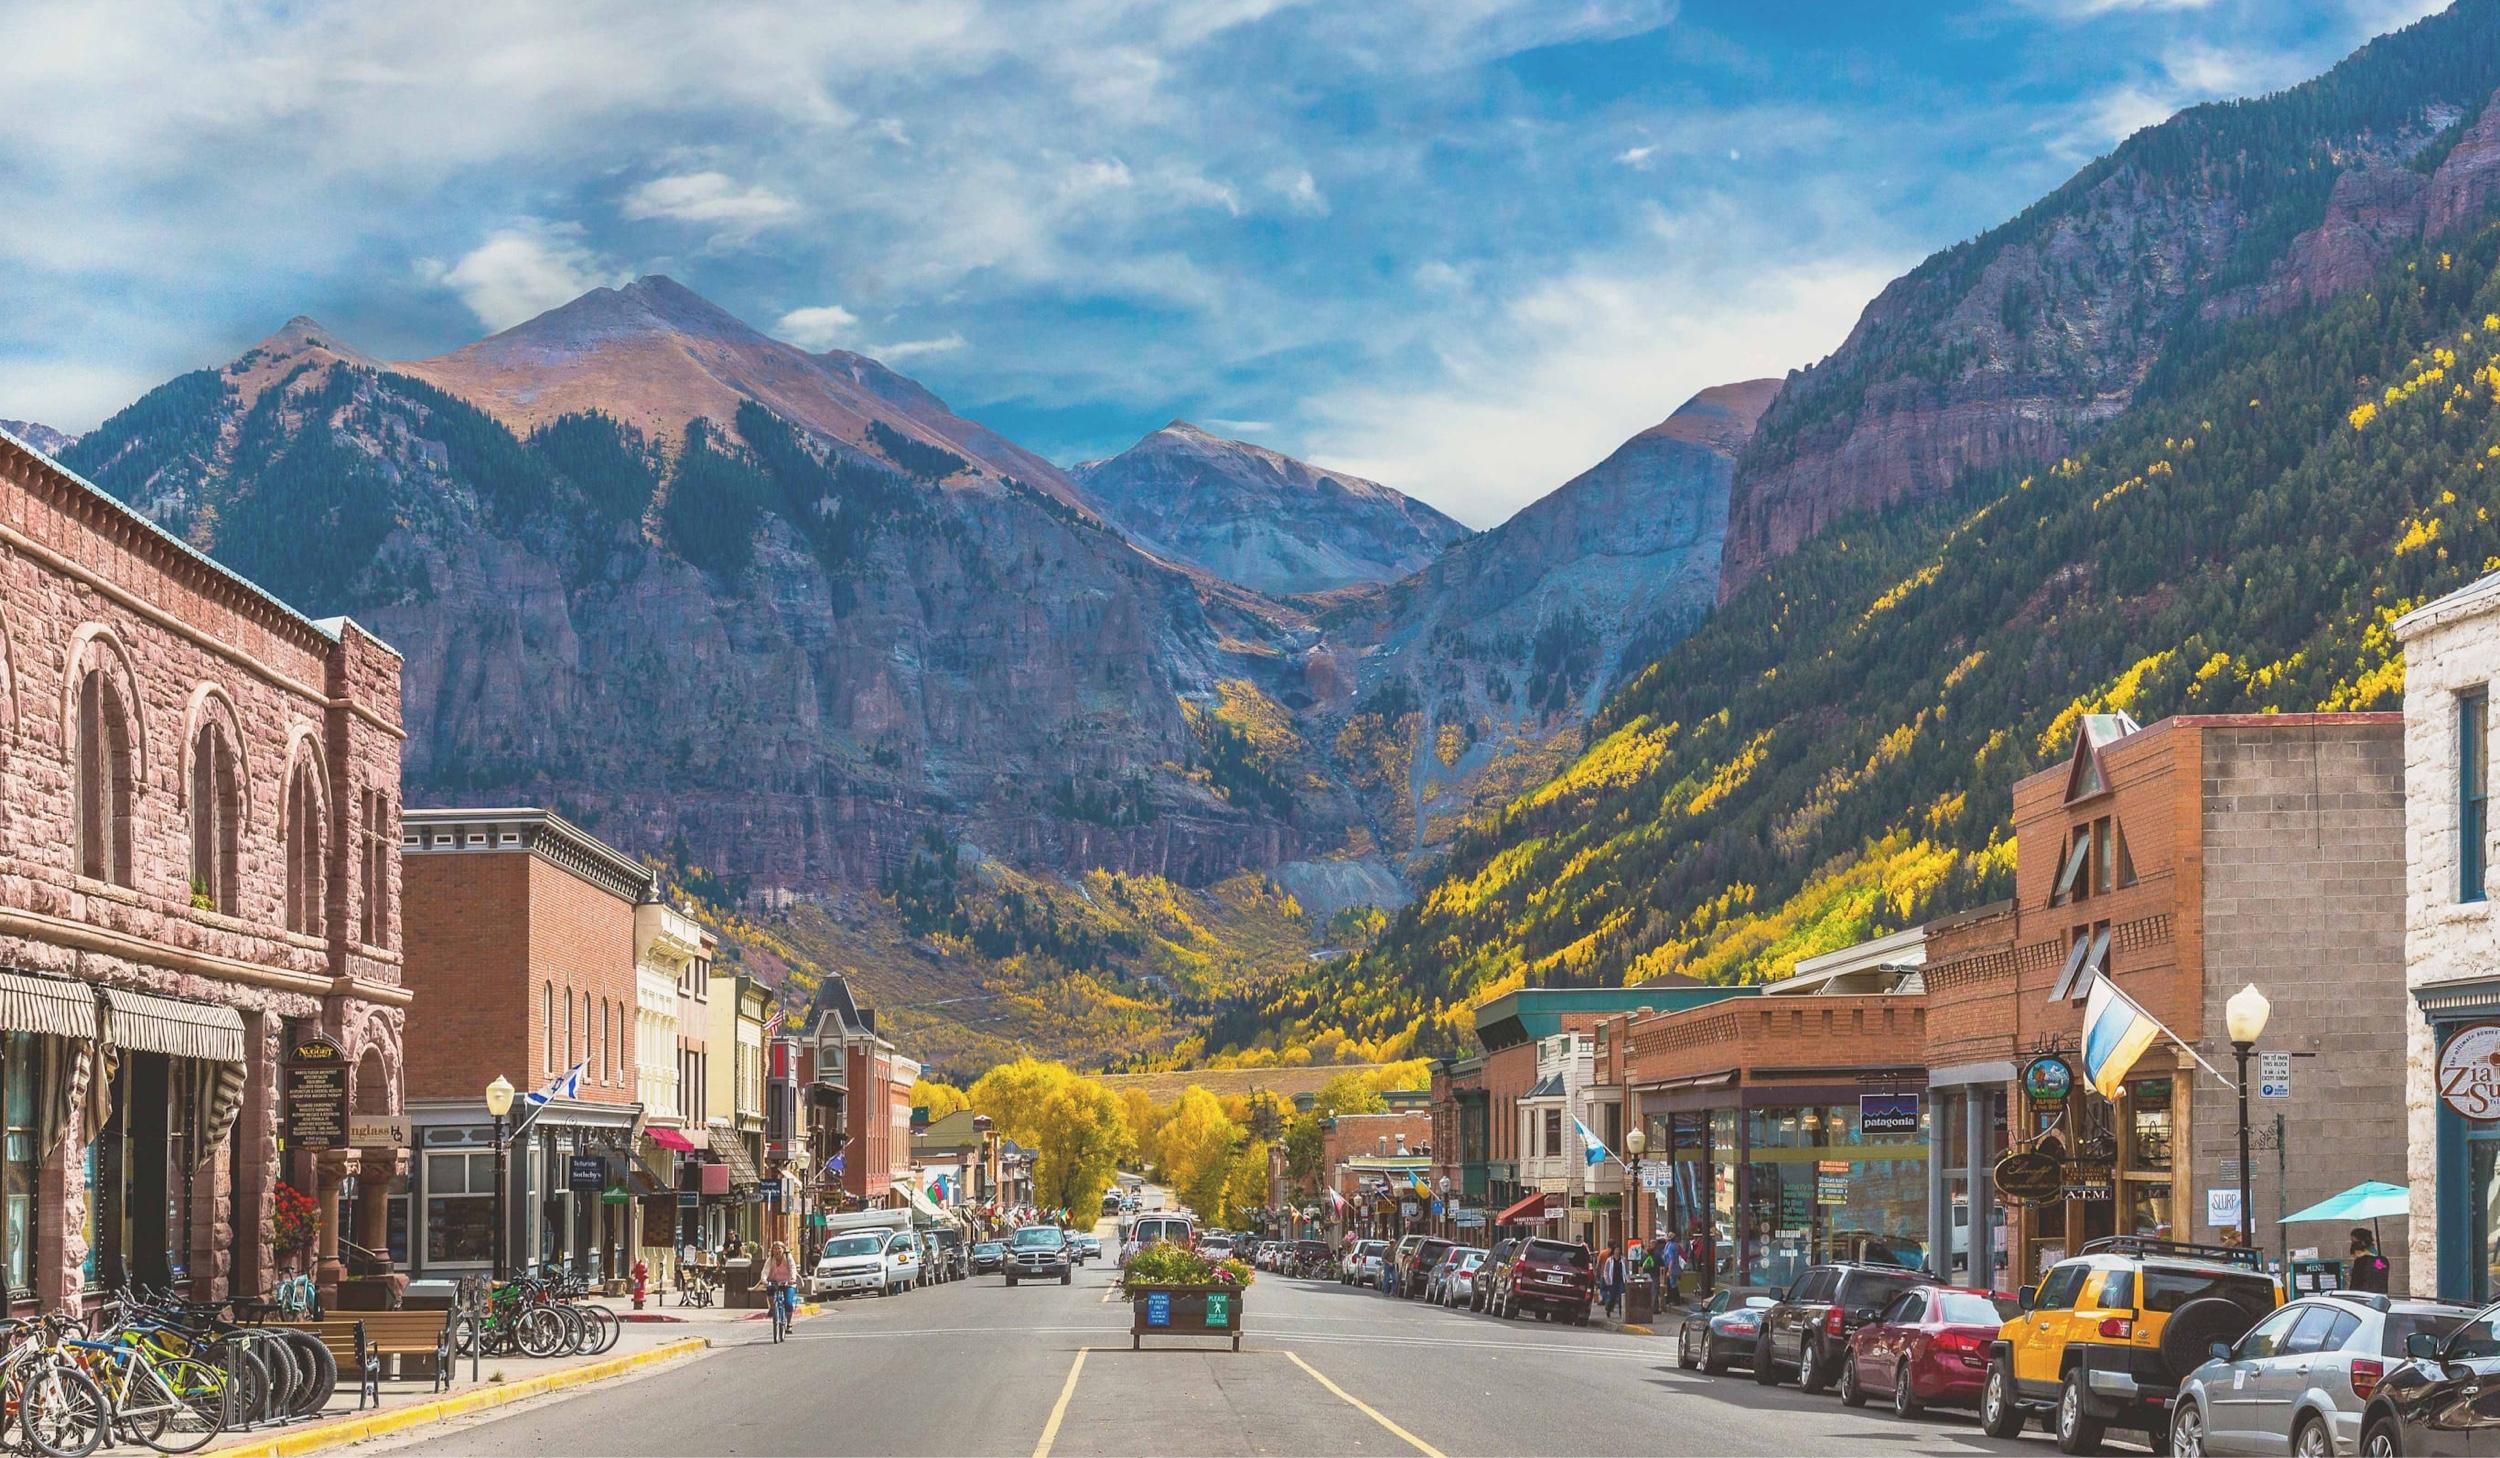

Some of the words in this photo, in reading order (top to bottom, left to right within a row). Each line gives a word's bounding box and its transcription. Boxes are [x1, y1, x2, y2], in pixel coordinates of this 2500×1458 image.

[2442, 1061, 2491, 1097] Zia
[1864, 1118, 1915, 1128] patagonia
[573, 1171, 601, 1179] Sotheby's
[2065, 1191, 2109, 1200] A.T.M.
[2212, 1194, 2237, 1210] SLURP
